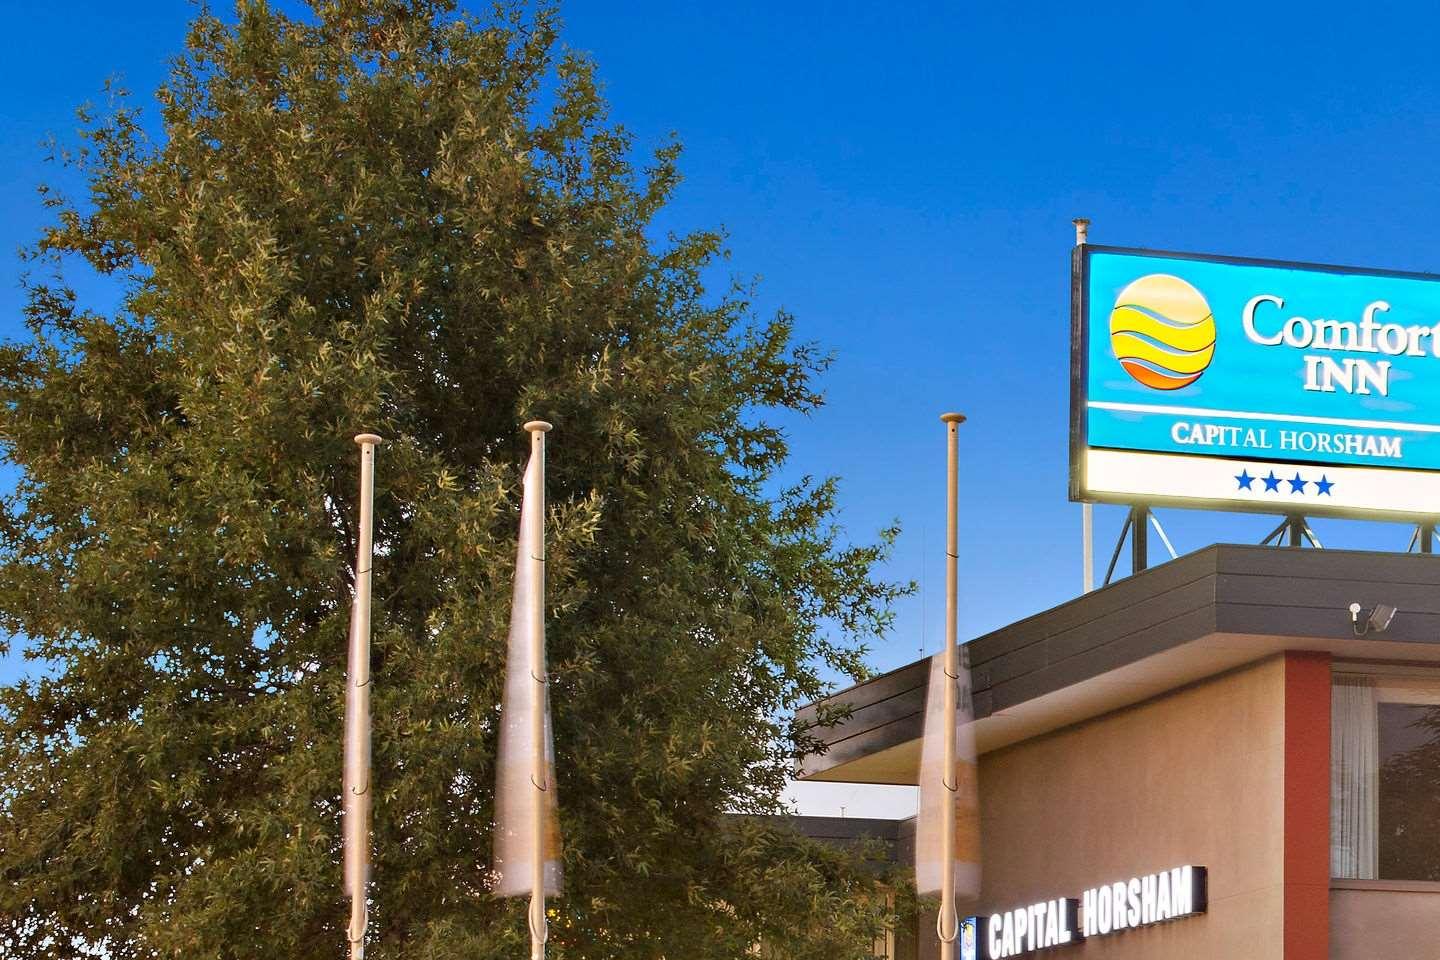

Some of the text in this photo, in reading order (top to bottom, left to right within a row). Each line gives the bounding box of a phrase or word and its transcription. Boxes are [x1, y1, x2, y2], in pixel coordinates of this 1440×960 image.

[1303, 355, 1392, 397] INN
[1171, 421, 1403, 458] CAPITAL HORSHAM
[988, 865, 1193, 960] CAPITAL HORSHAM
